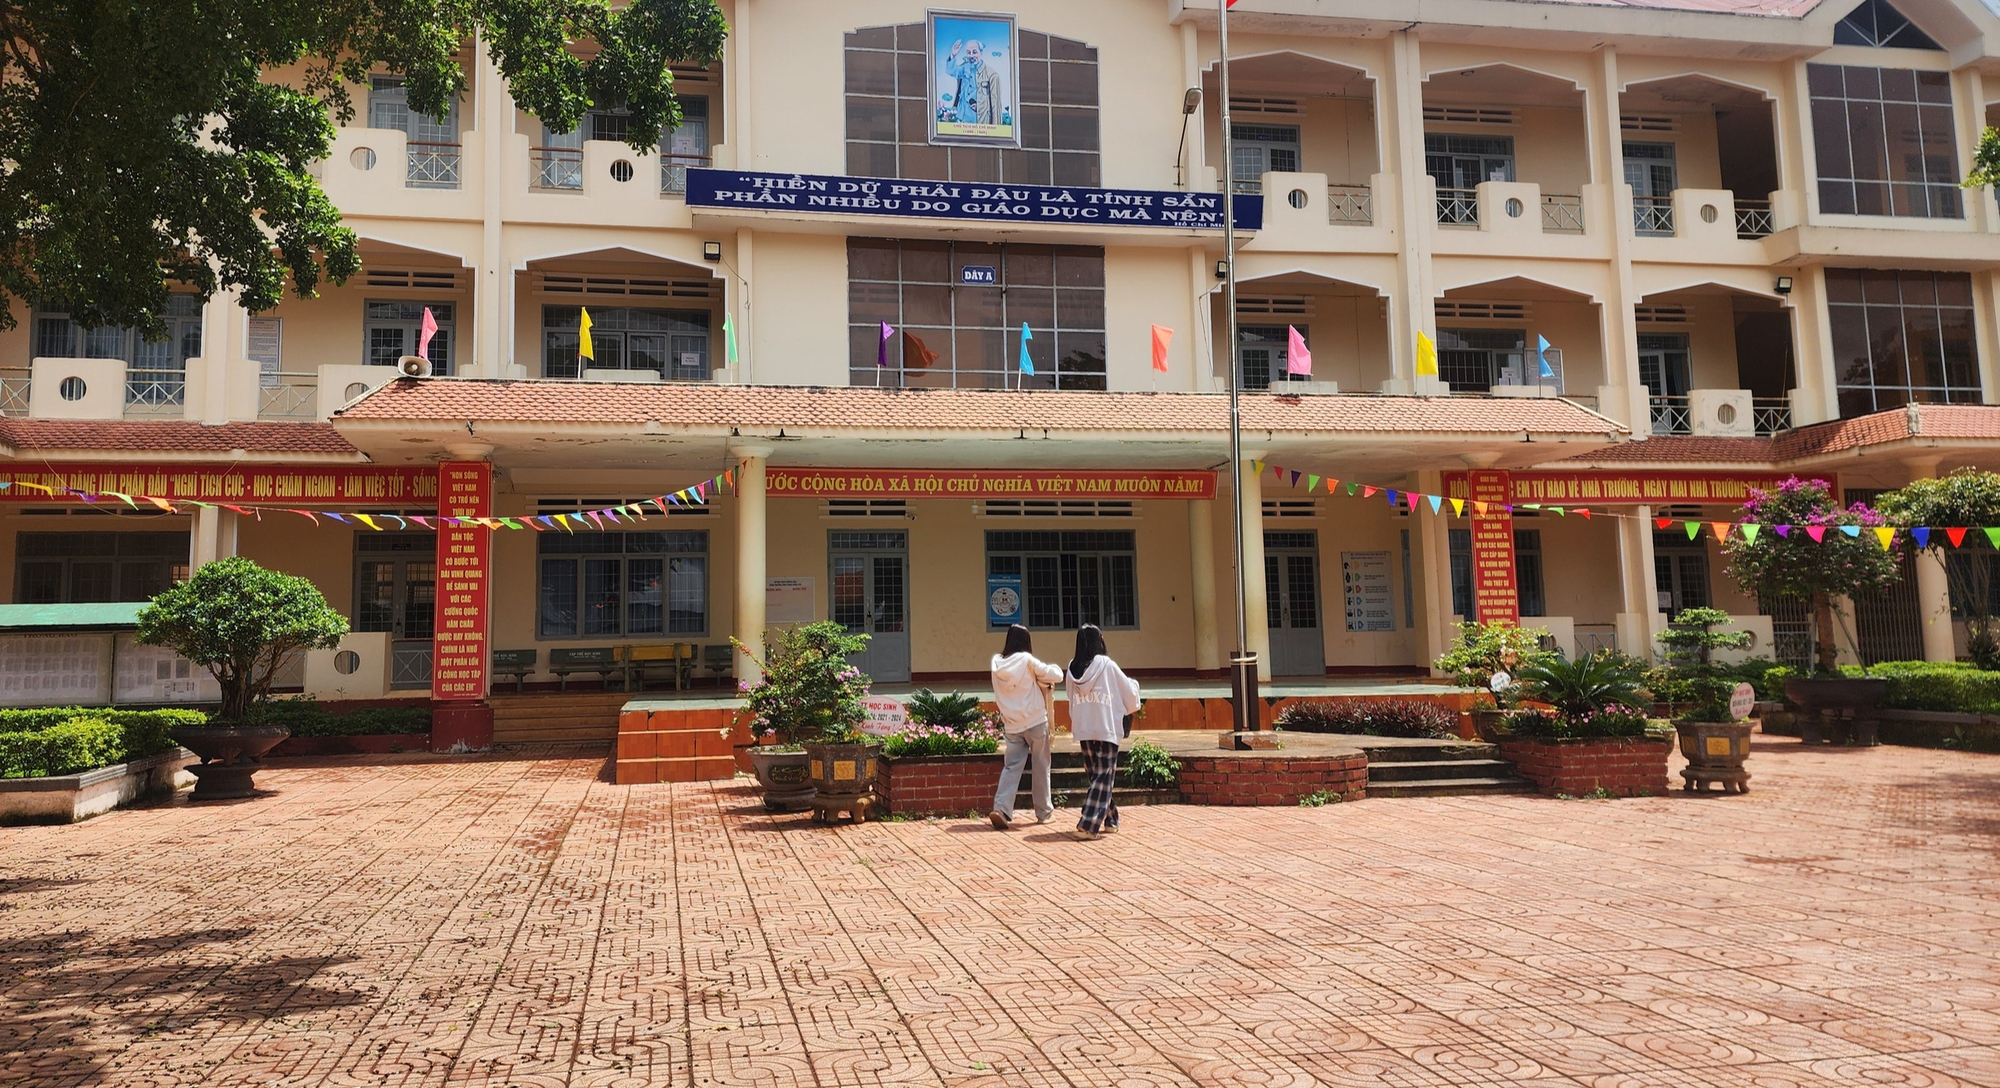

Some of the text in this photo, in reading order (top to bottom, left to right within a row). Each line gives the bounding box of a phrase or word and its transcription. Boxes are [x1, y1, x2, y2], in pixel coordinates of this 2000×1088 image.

[838, 181, 881, 194] DỮ
[890, 183, 960, 198] PHẢI
[970, 187, 1031, 201] ĐÂU
[1039, 190, 1076, 203] LÀ
[1085, 192, 1153, 206] TÍNH
[714, 187, 797, 204] PHẦN
[808, 193, 901, 210] NHIỀU
[911, 200, 951, 212] DO
[961, 201, 1031, 216] GIÁO
[1040, 206, 1099, 219] DỤC
[1108, 206, 1152, 221] MÀ
[986, 271, 993, 280] A
[15, 473, 39, 496] THPT
[41, 473, 67, 496] PHAN
[70, 470, 96, 496] ĐĂNG
[120, 466, 144, 496] PHẤN
[147, 467, 167, 496] ĐẤU
[200, 471, 221, 497] TÍCH
[225, 472, 245, 500] CỰC
[253, 475, 273, 501] HỌC
[275, 472, 303, 498] CHĂM
[305, 475, 336, 497] NGOAN
[344, 472, 363, 497] LÀM
[365, 472, 385, 501] VIỆC
[388, 469, 405, 498] TỐT
[413, 469, 437, 498] SỐNG
[465, 484, 477, 492] NAM
[801, 473, 846, 494] CỘNG
[849, 474, 885, 491] HÒA
[888, 475, 910, 492] XÃ
[913, 475, 943, 495] HỘI
[947, 474, 980, 492] CHỦ
[982, 475, 1033, 492] NGHĨA
[1036, 475, 1073, 495] VIỆT
[1076, 478, 1112, 492] NAM
[1114, 476, 1160, 492] MUÔN
[1164, 476, 1204, 492] NĂM!
[1516, 480, 1530, 498] EM
[1532, 478, 1545, 501] TỰ
[1547, 477, 1566, 498] HÀO
[1568, 474, 1580, 498] VỀ
[1582, 477, 1600, 498] NHÀ
[1602, 477, 1642, 499] TRƯỜNG,
[1644, 477, 1668, 498] NGÀY
[1670, 480, 1687, 498] MAI
[1689, 478, 1709, 498] NHÀ
[1710, 478, 1747, 498] TRƯỜNG
[463, 545, 475, 553] NAM
[464, 570, 483, 579] QUANG
[453, 632, 464, 641] HAY
[869, 702, 881, 711] HỌC
[883, 703, 897, 711] SINH
